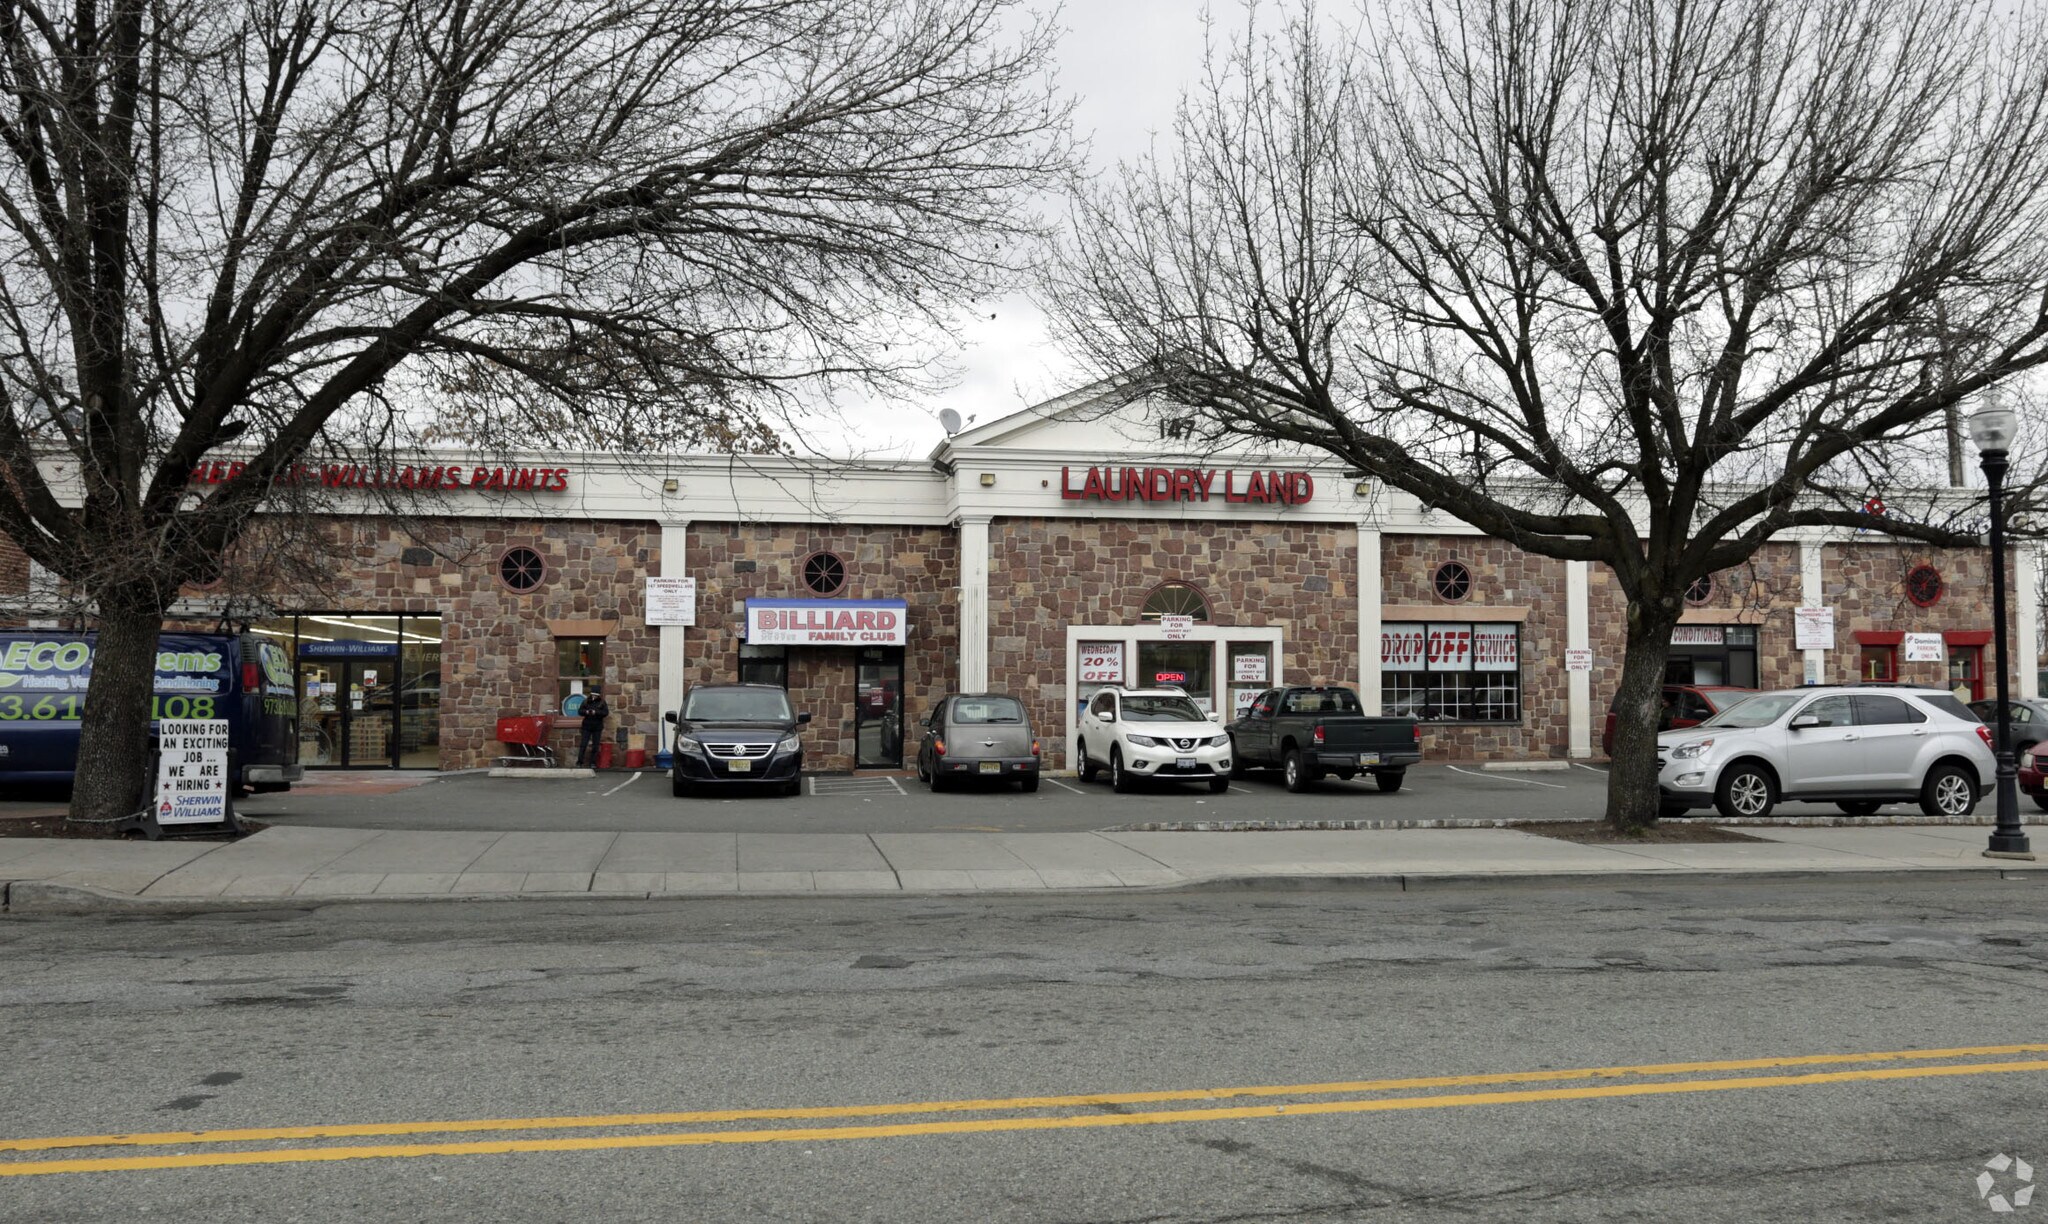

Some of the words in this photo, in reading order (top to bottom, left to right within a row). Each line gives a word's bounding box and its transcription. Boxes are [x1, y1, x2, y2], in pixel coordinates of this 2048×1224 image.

[469, 466, 570, 492] PAINTS
[1061, 466, 1217, 502] LAUNDRY
[1225, 469, 1315, 505] LAND
[757, 610, 897, 631] BILLIARD
[808, 631, 857, 641] FAMILY
[859, 632, 896, 642] CLUB
[1673, 626, 1723, 643] CONDITIONED
[1081, 645, 1118, 654] WEDNESDAY
[1380, 632, 1424, 665] DROP
[1426, 631, 1471, 663] OFF
[1472, 633, 1516, 664] SERVICE
[1, 641, 90, 671] ECO
[1083, 671, 1119, 681] OFF
[1156, 673, 1184, 681] OPEN
[1239, 692, 1260, 703] OPE
[161, 723, 206, 735] LOOKING
[209, 724, 228, 735] FOR
[163, 738, 177, 749] AN
[183, 738, 228, 749] EXCITING
[183, 752, 203, 763] JOB
[169, 766, 184, 777] WE
[199, 765, 219, 776] ARE
[176, 779, 210, 791] HIRING
[176, 795, 222, 806] SHERWIN
[173, 807, 222, 817] WILLIAMS
